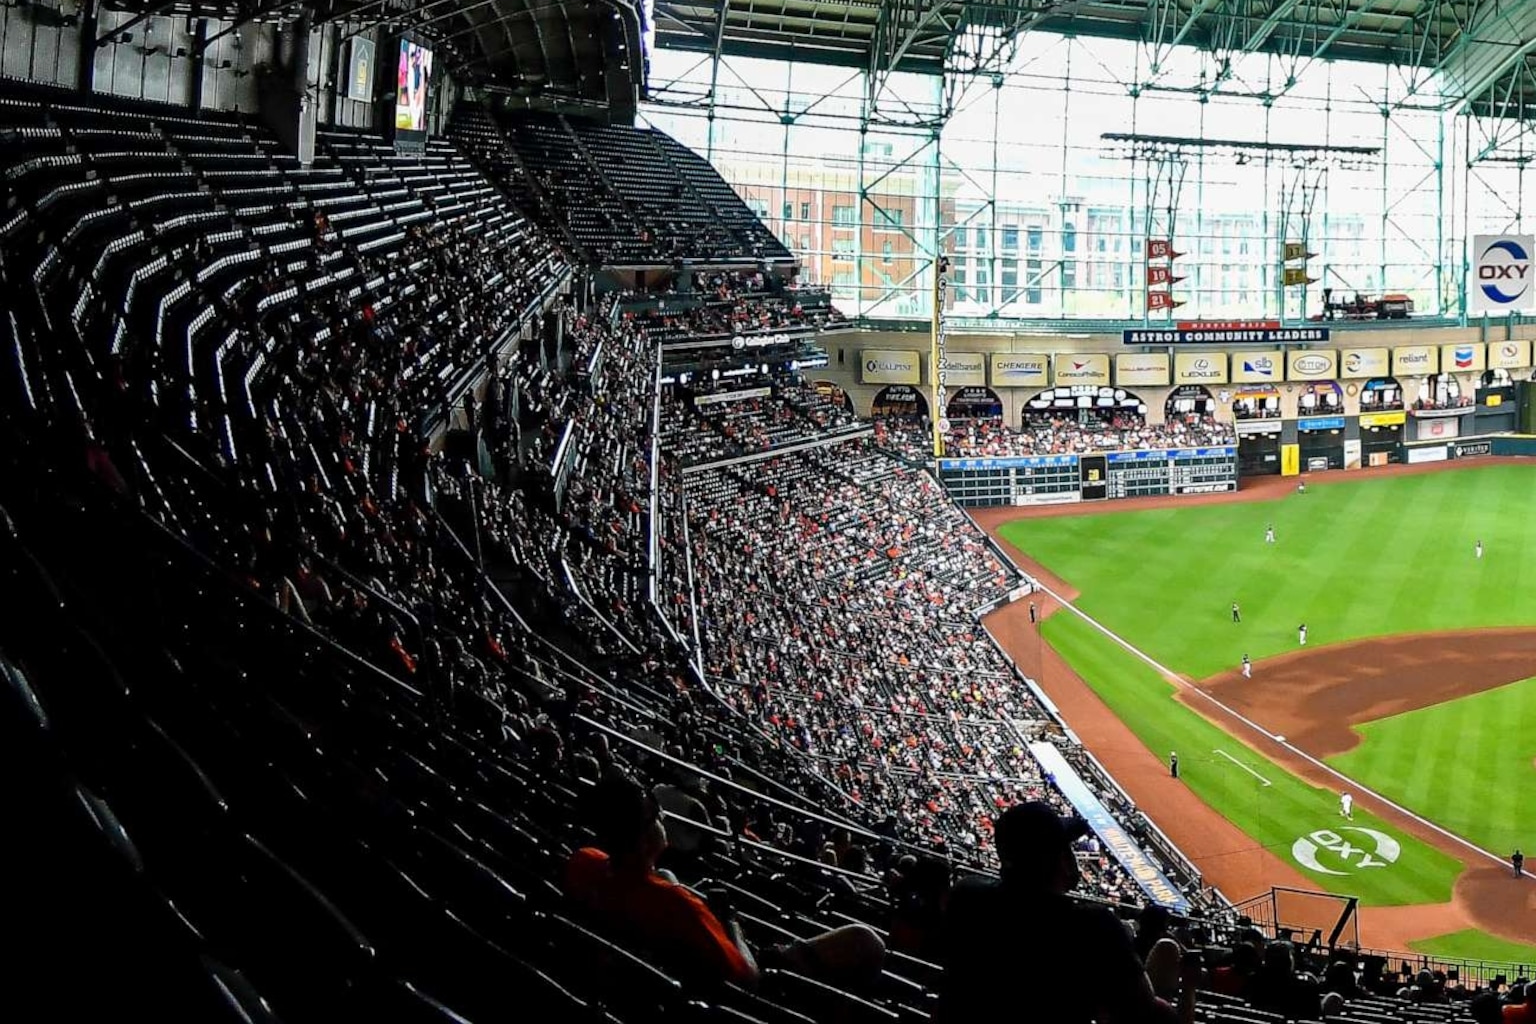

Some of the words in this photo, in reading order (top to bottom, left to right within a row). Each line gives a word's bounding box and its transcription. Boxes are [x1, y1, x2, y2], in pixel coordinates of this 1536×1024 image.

[1152, 243, 1166, 254] 05
[1478, 264, 1530, 280] OXY
[1151, 294, 1164, 306] 21
[937, 279, 946, 346] CHIKIN
[1130, 332, 1180, 342] ASTROS
[1185, 330, 1264, 342] COMMUNITY
[1268, 329, 1323, 340] LEADERS
[937, 348, 948, 369] IZ
[1255, 356, 1273, 369] slb
[1399, 352, 1428, 364] reliant
[878, 361, 913, 372] CALPINE
[997, 361, 1043, 370] CHENIERE
[1057, 370, 1106, 378] ConocoPhillips
[1181, 370, 1222, 378] LEXUS
[937, 372, 947, 417] FAIR
[1308, 828, 1388, 869] OXY
[1147, 878, 1180, 904] PARK
